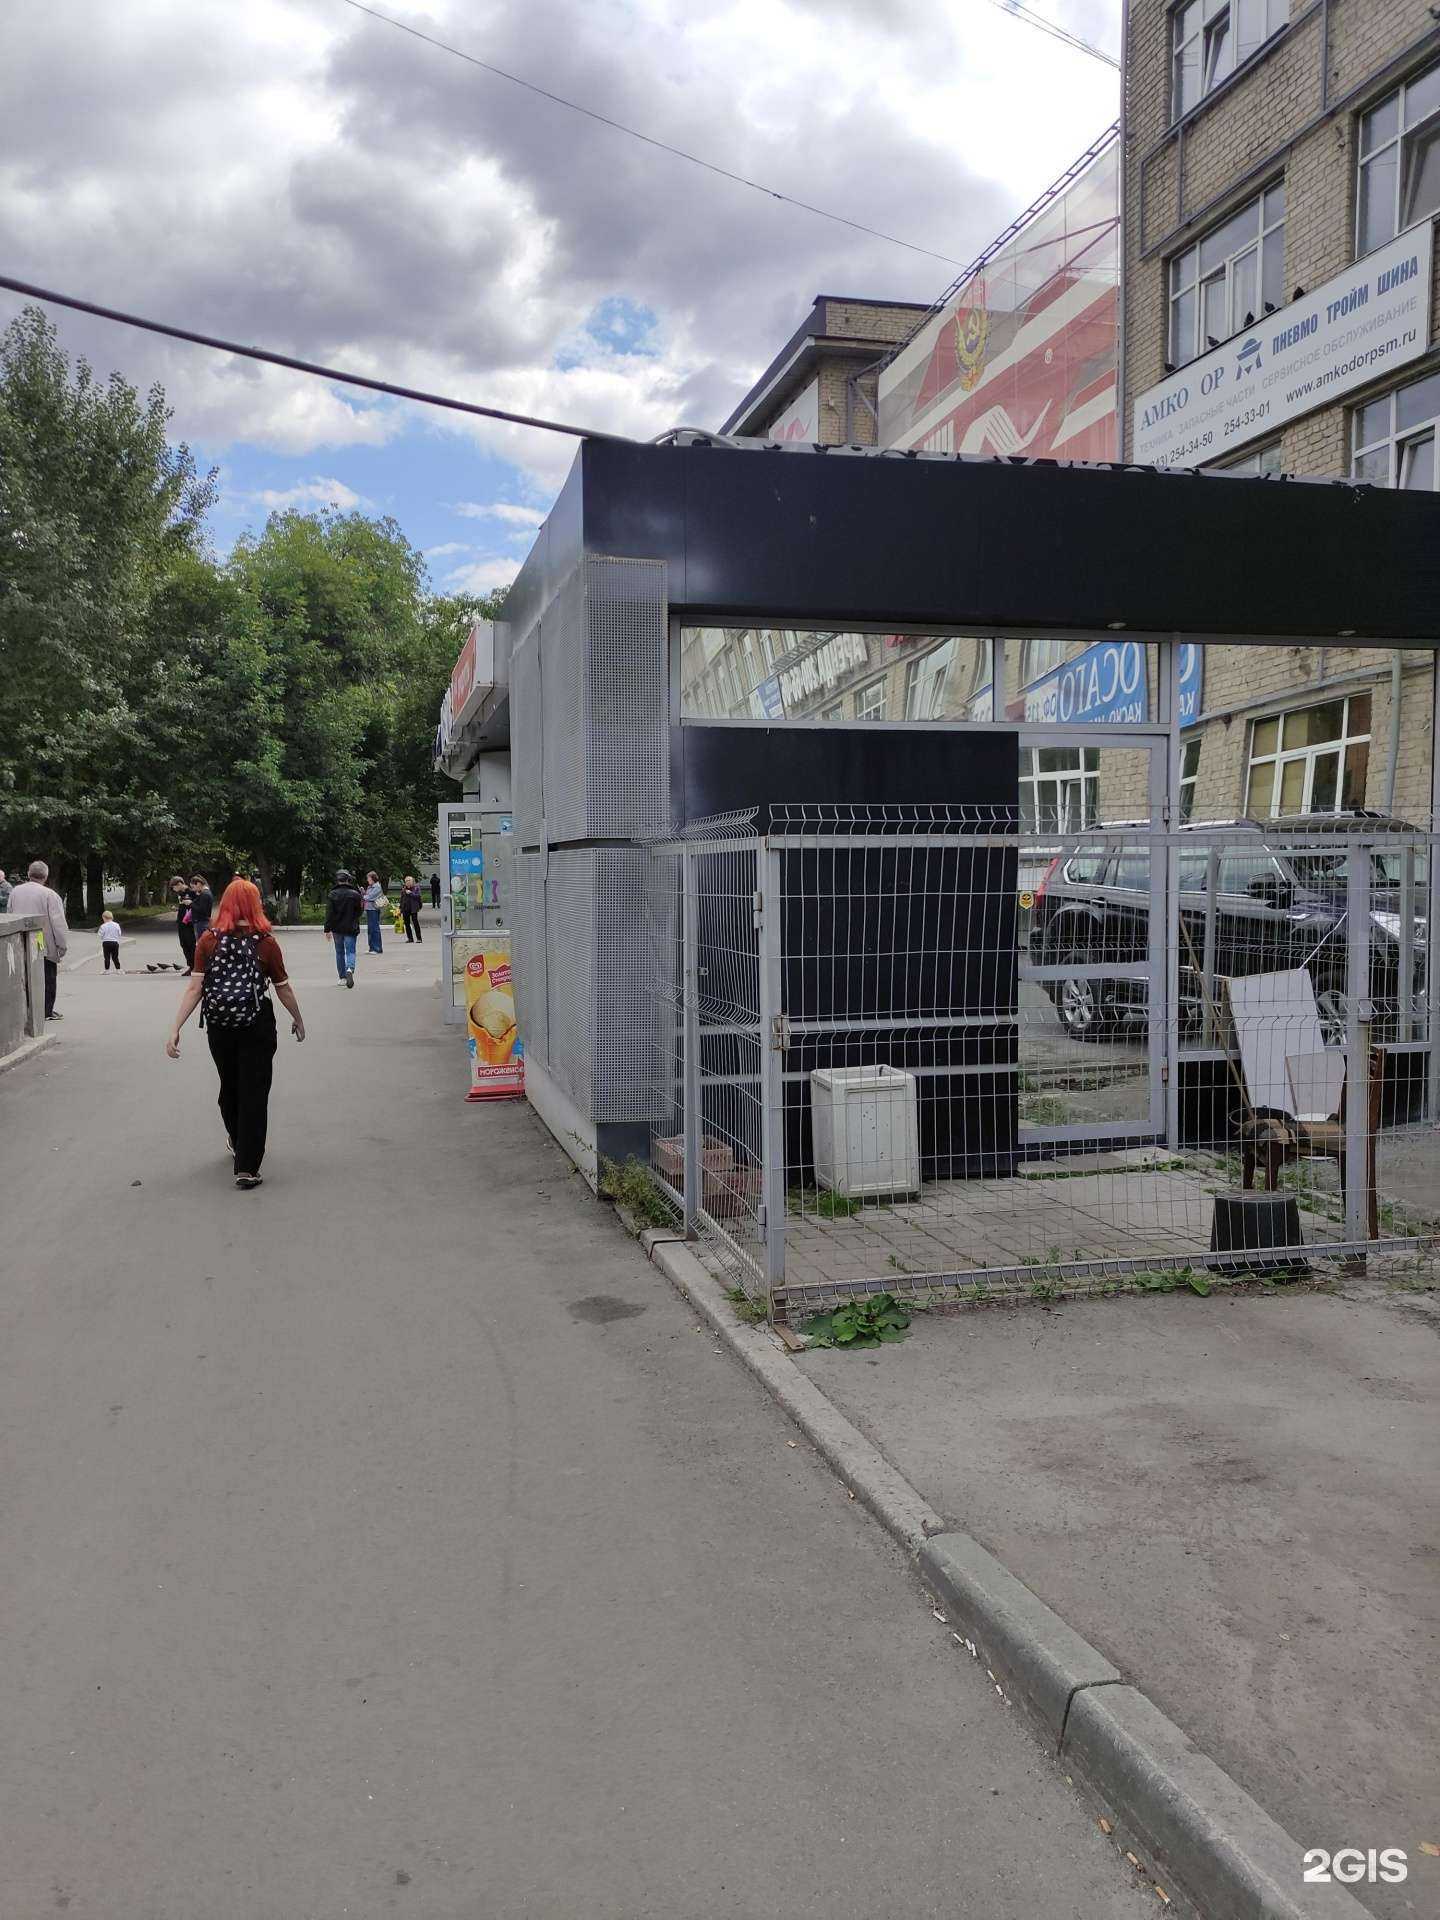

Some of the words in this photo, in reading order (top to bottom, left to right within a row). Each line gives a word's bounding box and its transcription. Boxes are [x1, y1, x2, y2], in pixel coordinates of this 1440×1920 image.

[1262, 347, 1321, 389] СЕРВИСНОЕ
[1323, 296, 1417, 357] ОБСЛУЖИВАНИЕ
[1272, 314, 1318, 355] ПНЕВМО
[1327, 284, 1369, 325] ТРОЙМ
[1377, 256, 1418, 297] ШИНА
[1170, 431, 1213, 462] 254-34-50
[1223, 400, 1271, 436] 254-33-01
[1285, 329, 1417, 402] www.amkodorpsm.ru
